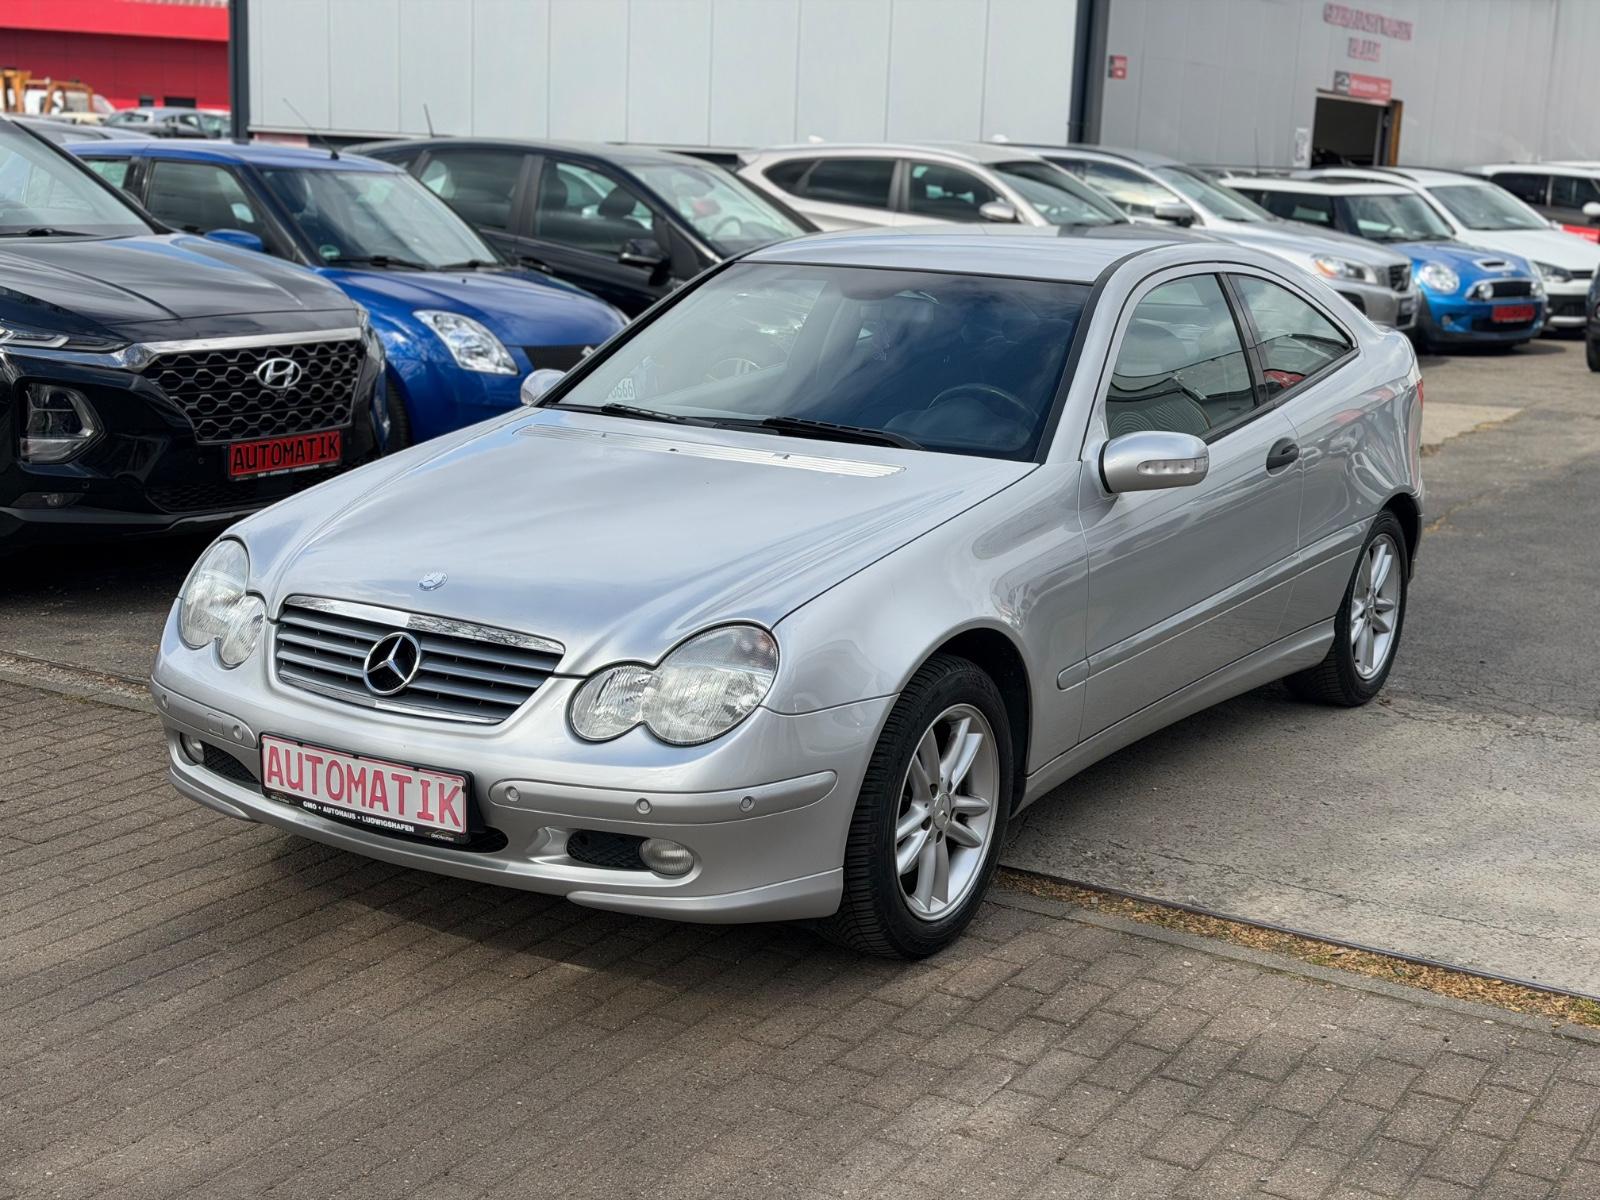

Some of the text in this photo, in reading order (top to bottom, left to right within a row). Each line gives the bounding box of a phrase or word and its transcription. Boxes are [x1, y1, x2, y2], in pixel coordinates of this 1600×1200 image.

[233, 434, 338, 471] AUTOMATIK
[267, 745, 461, 827] AUTOMATIK
[323, 805, 356, 820] AUTOHAUS
[362, 815, 414, 833] LUDWIGSHAFEN
